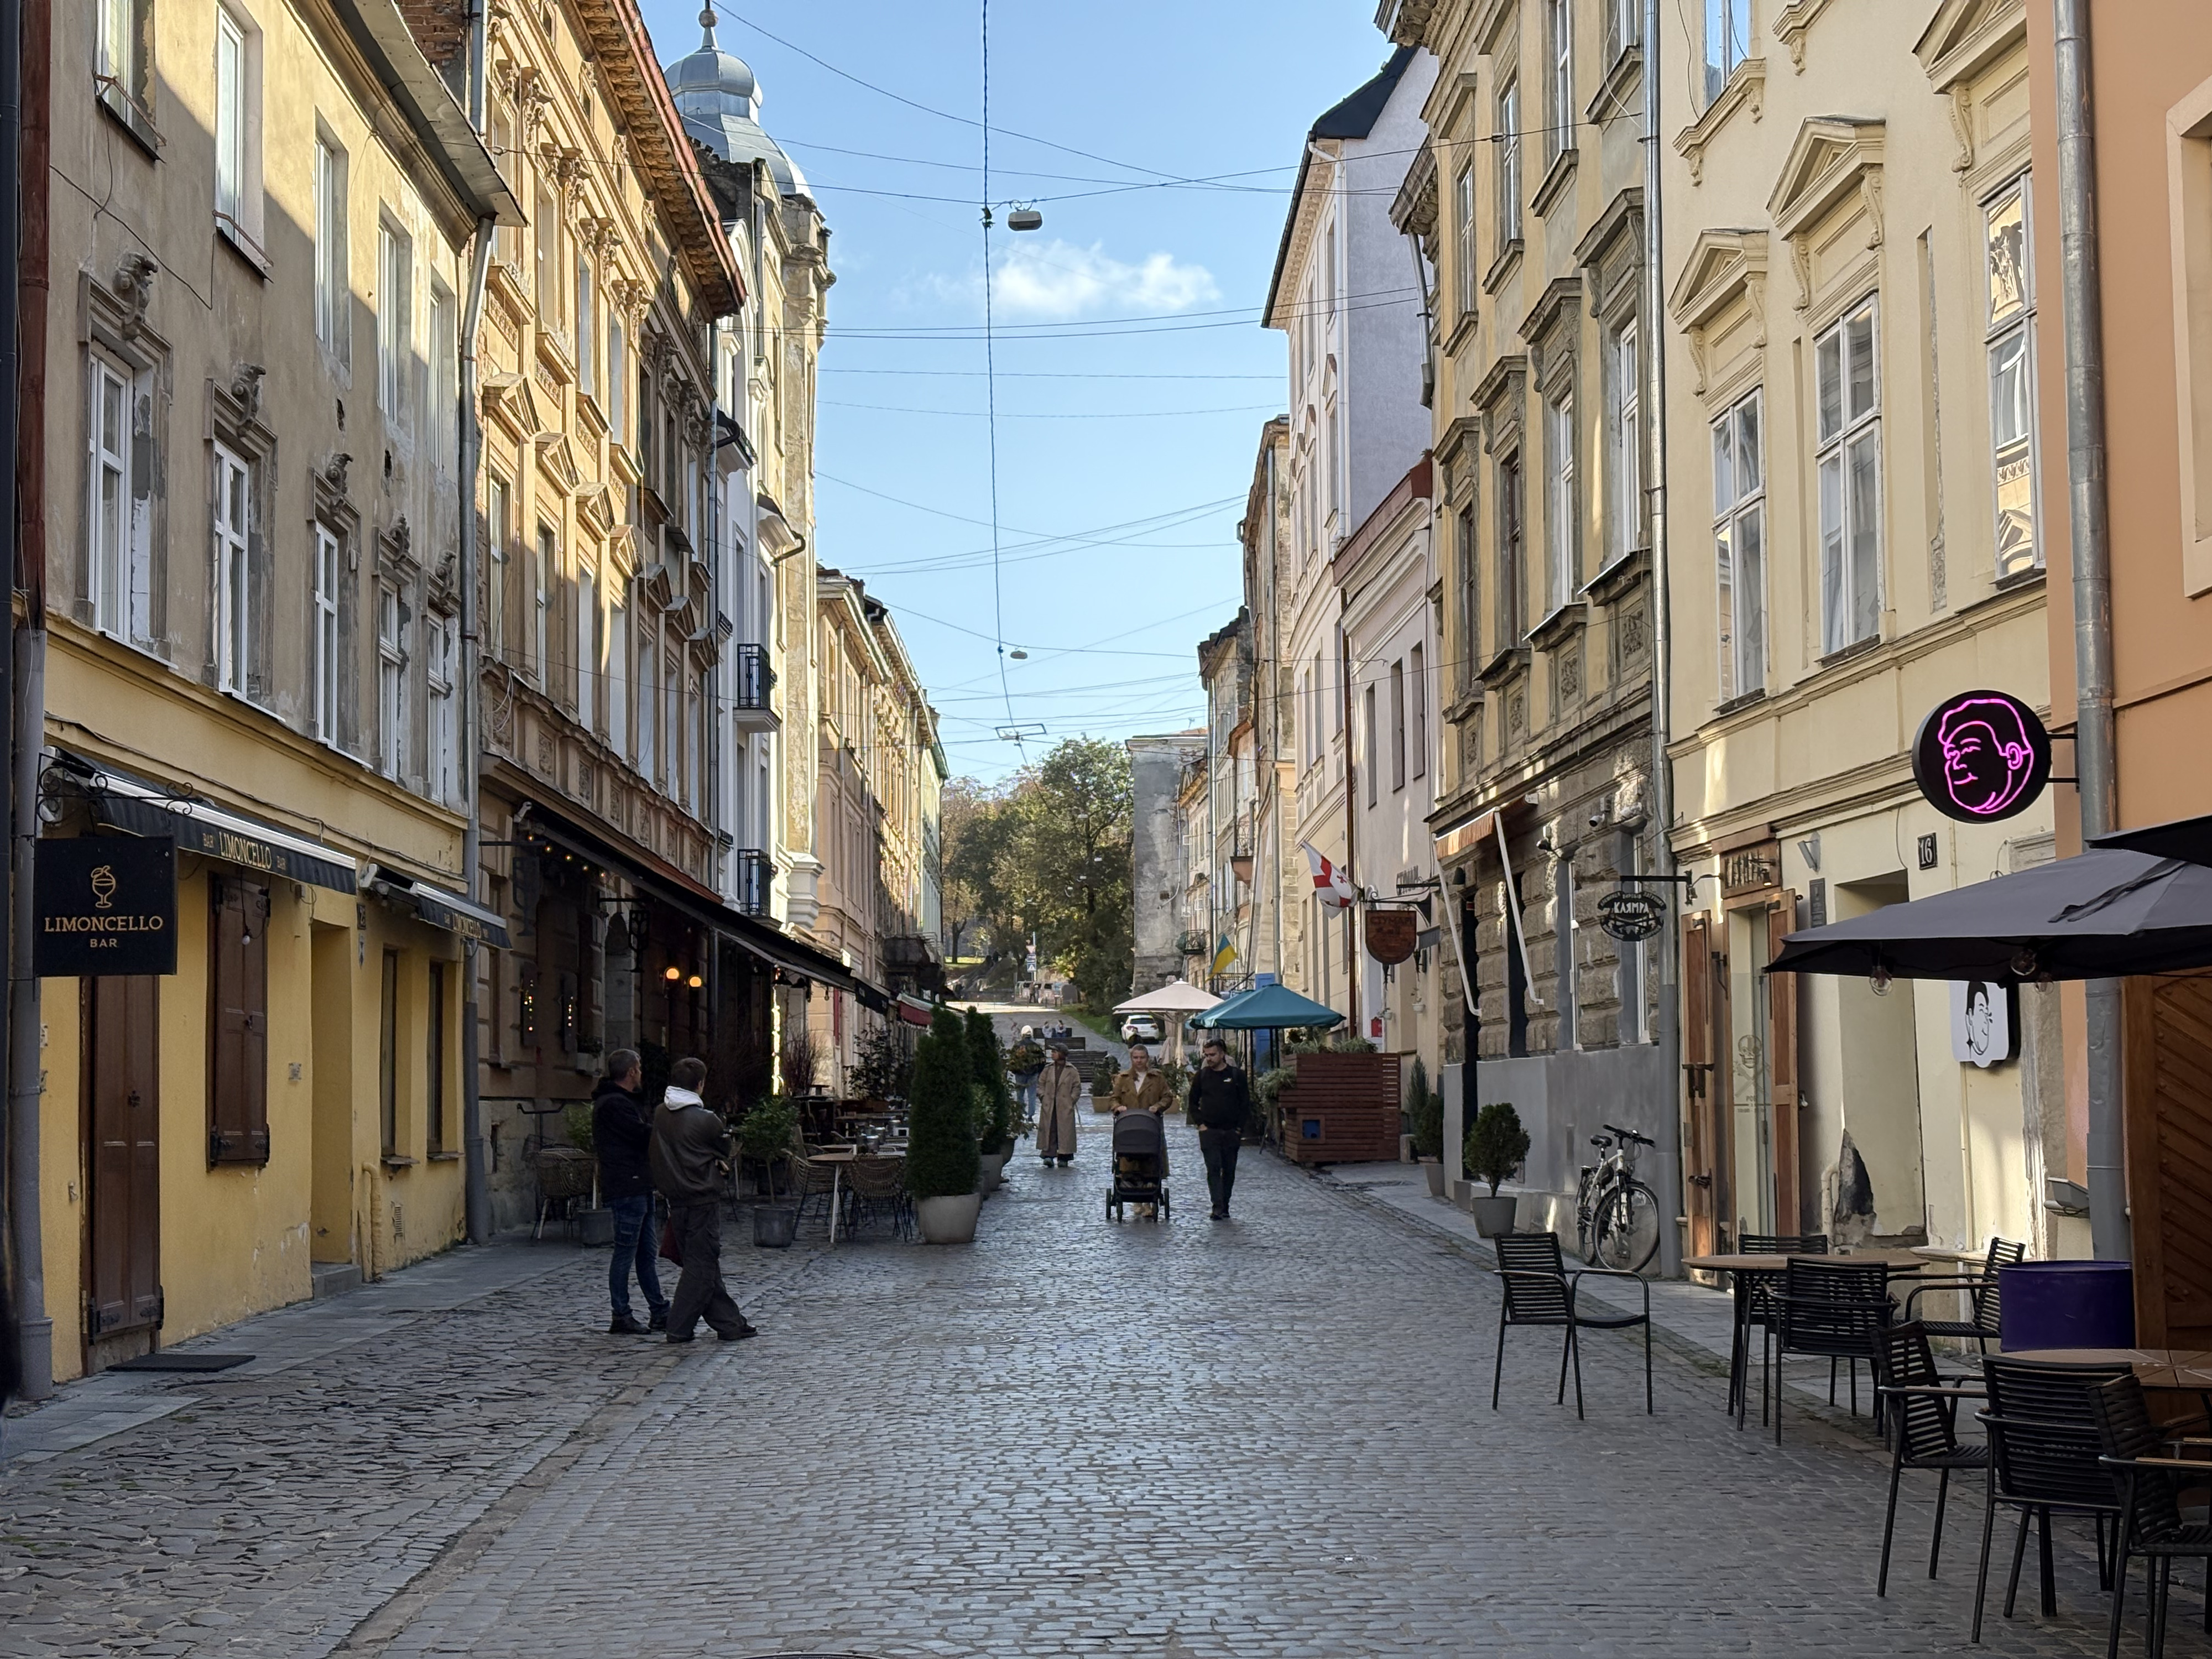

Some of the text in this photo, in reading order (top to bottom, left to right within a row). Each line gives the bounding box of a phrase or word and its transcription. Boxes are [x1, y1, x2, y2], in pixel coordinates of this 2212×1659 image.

[202, 833, 215, 848] BAR
[219, 831, 272, 870] LIMONCELLO
[1920, 838, 1933, 864] 16
[1614, 901, 1649, 914] КЛЯМРА
[44, 915, 164, 932] LIMONCELLO
[90, 938, 118, 948] BAR
